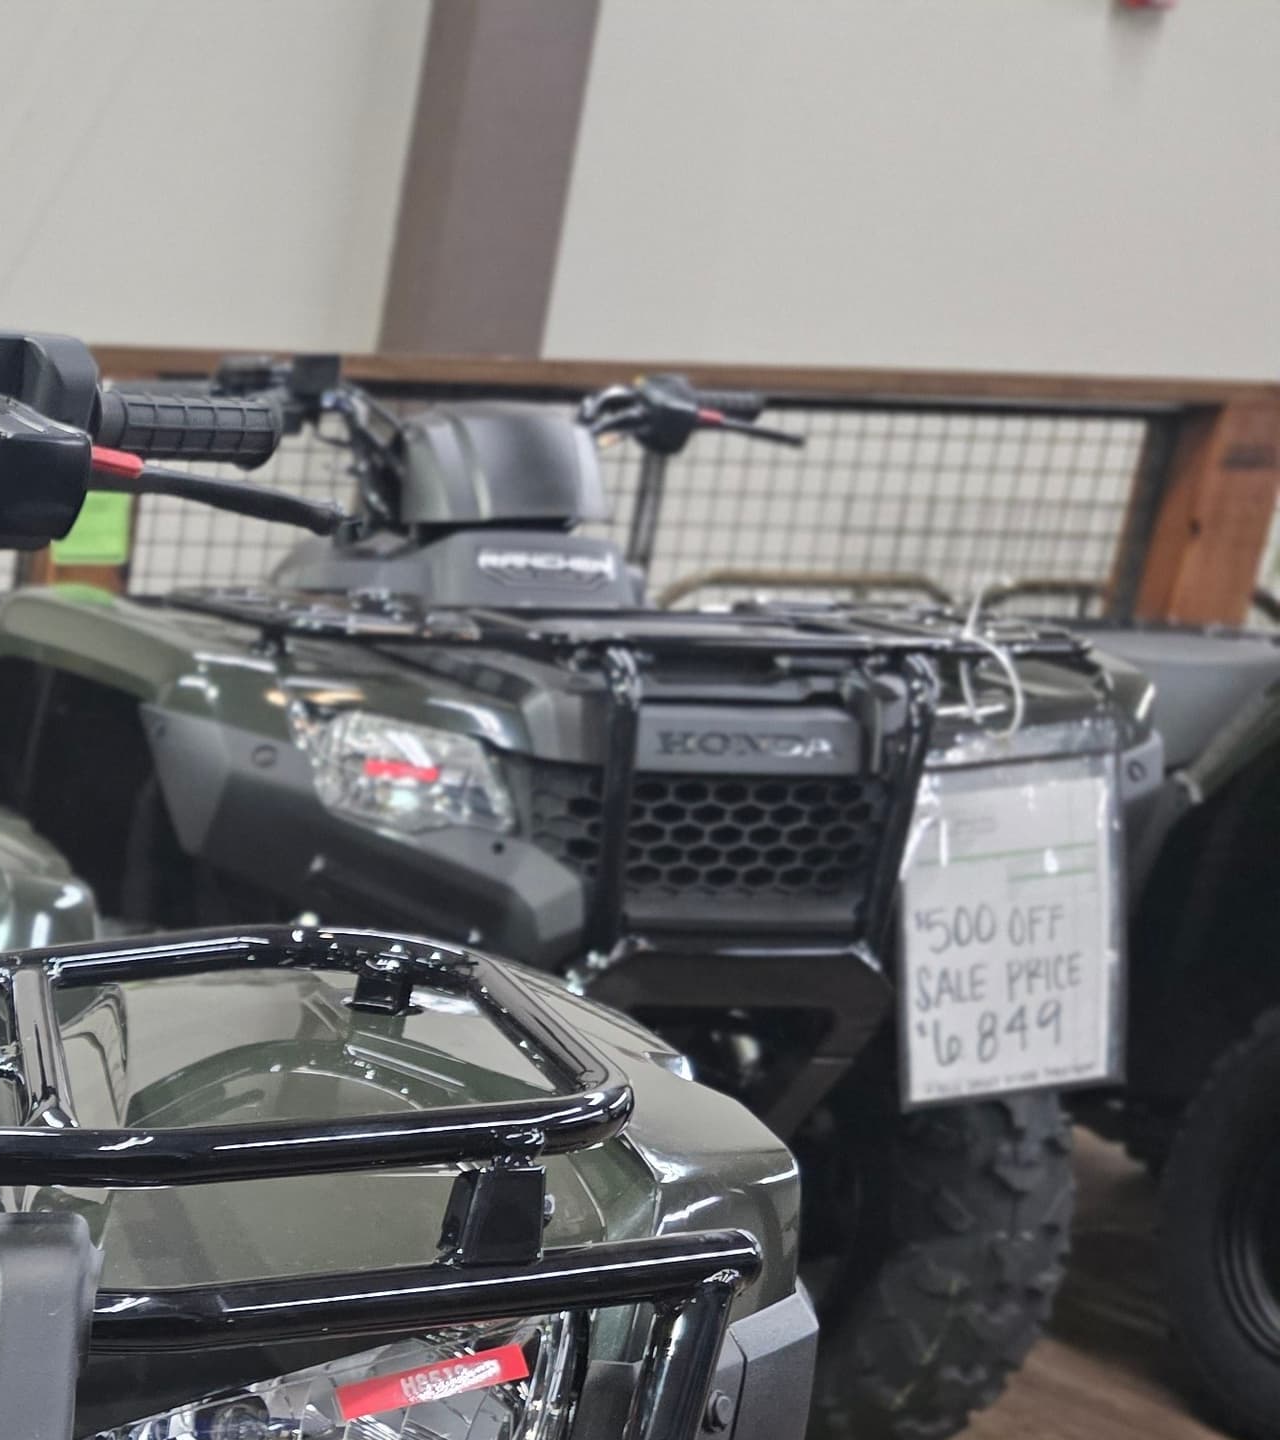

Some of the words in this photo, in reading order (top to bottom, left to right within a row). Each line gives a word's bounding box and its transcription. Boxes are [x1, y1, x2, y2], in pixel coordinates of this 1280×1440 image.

[655, 729, 839, 759] HONDA
[1007, 903, 1065, 947] OFF
[915, 963, 988, 1014] SALE
[1006, 951, 1084, 1003] PRICE
